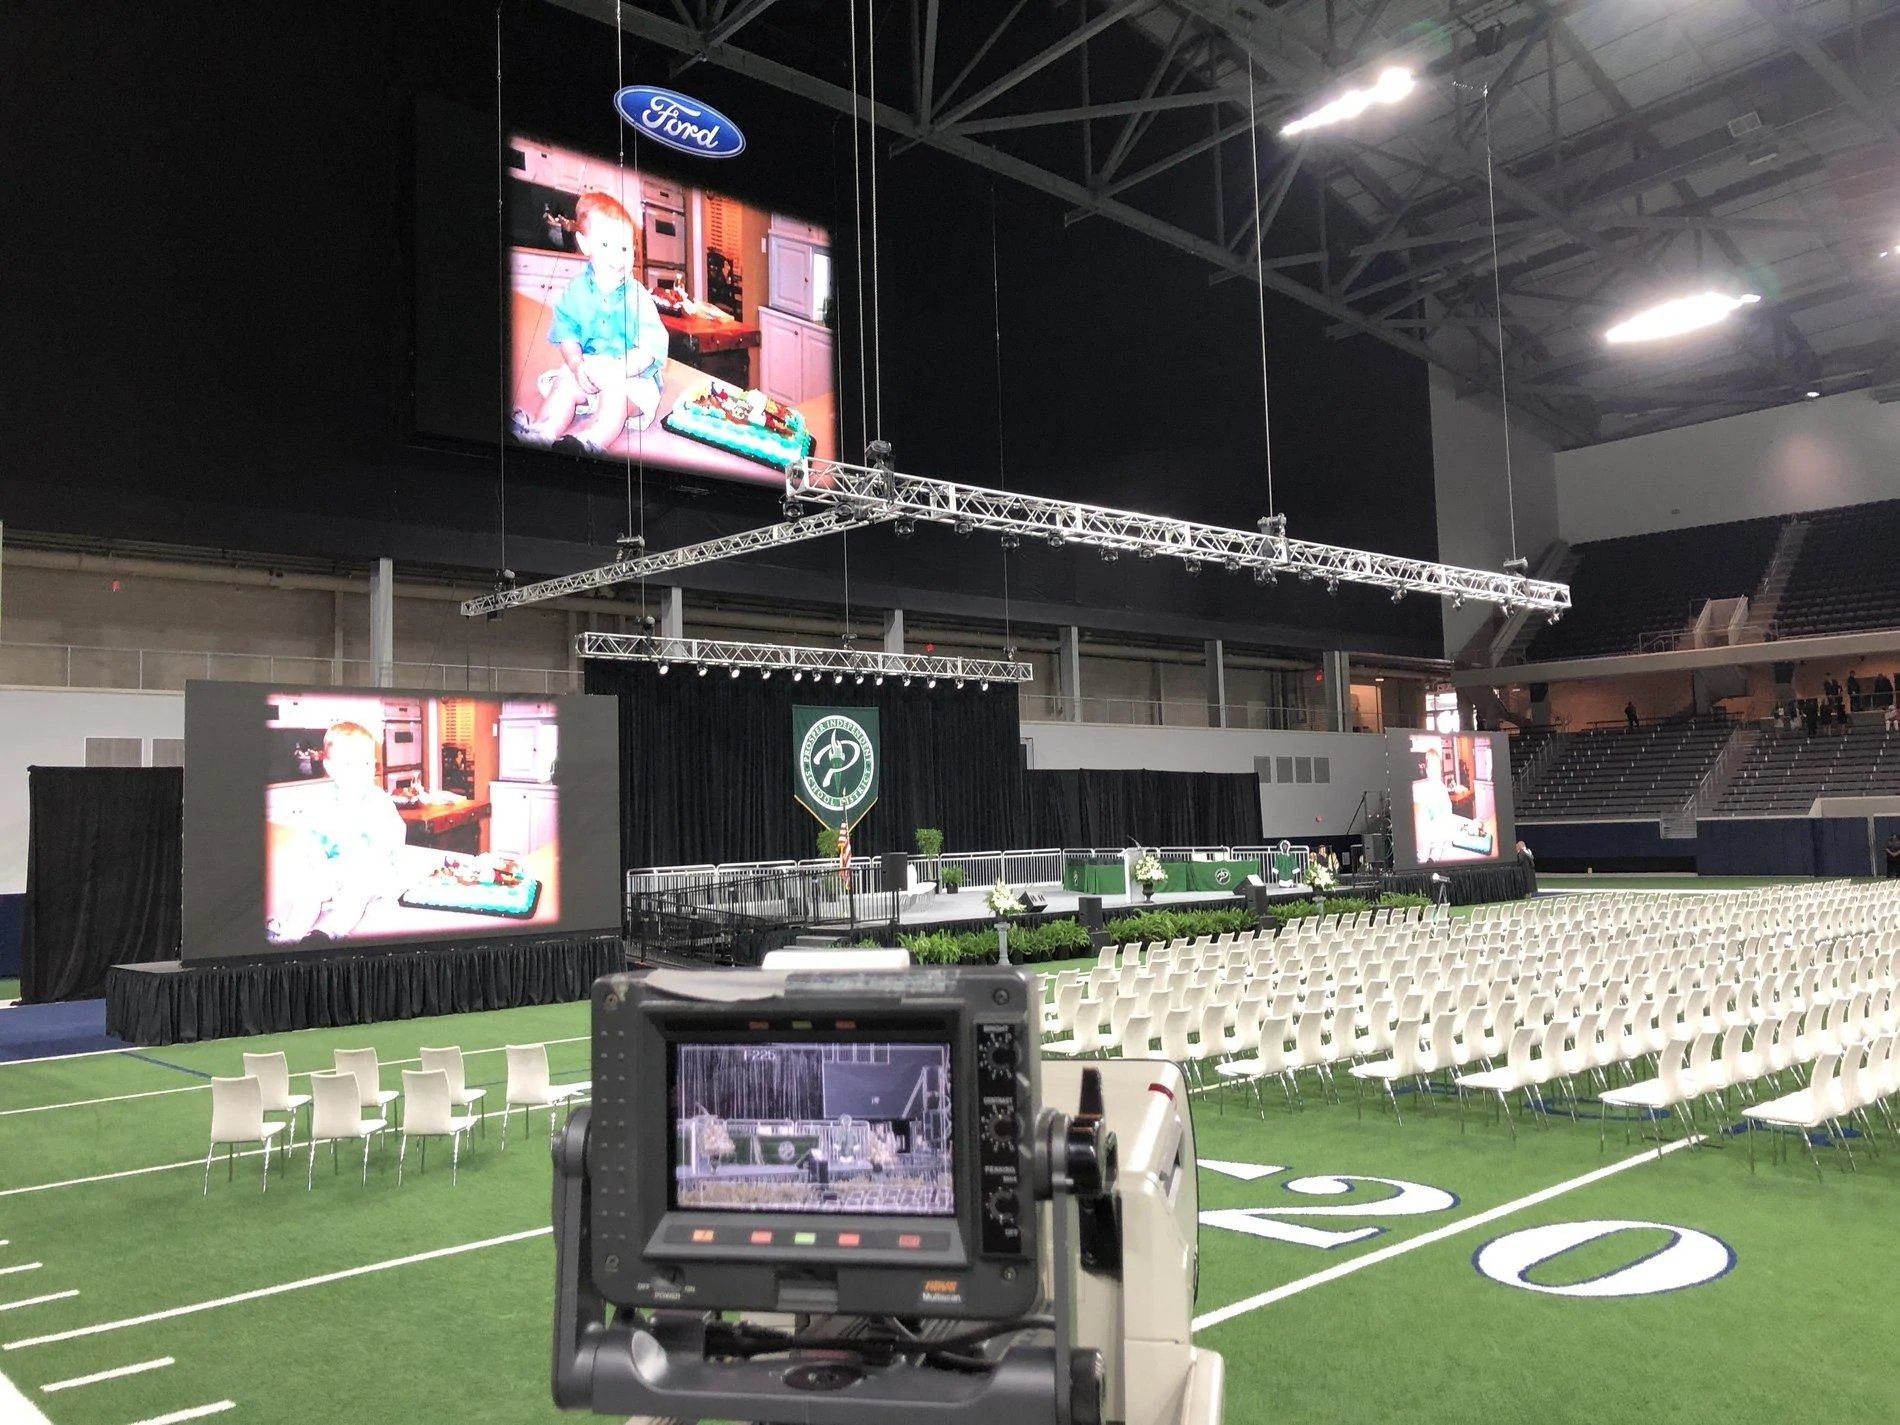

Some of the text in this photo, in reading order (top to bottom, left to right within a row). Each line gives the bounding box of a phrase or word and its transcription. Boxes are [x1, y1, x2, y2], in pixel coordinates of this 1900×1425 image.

[642, 96, 719, 149] Ford
[803, 724, 826, 763] PROSPER
[805, 770, 835, 806] SCHOOL
[654, 1291, 680, 1300] POWER
